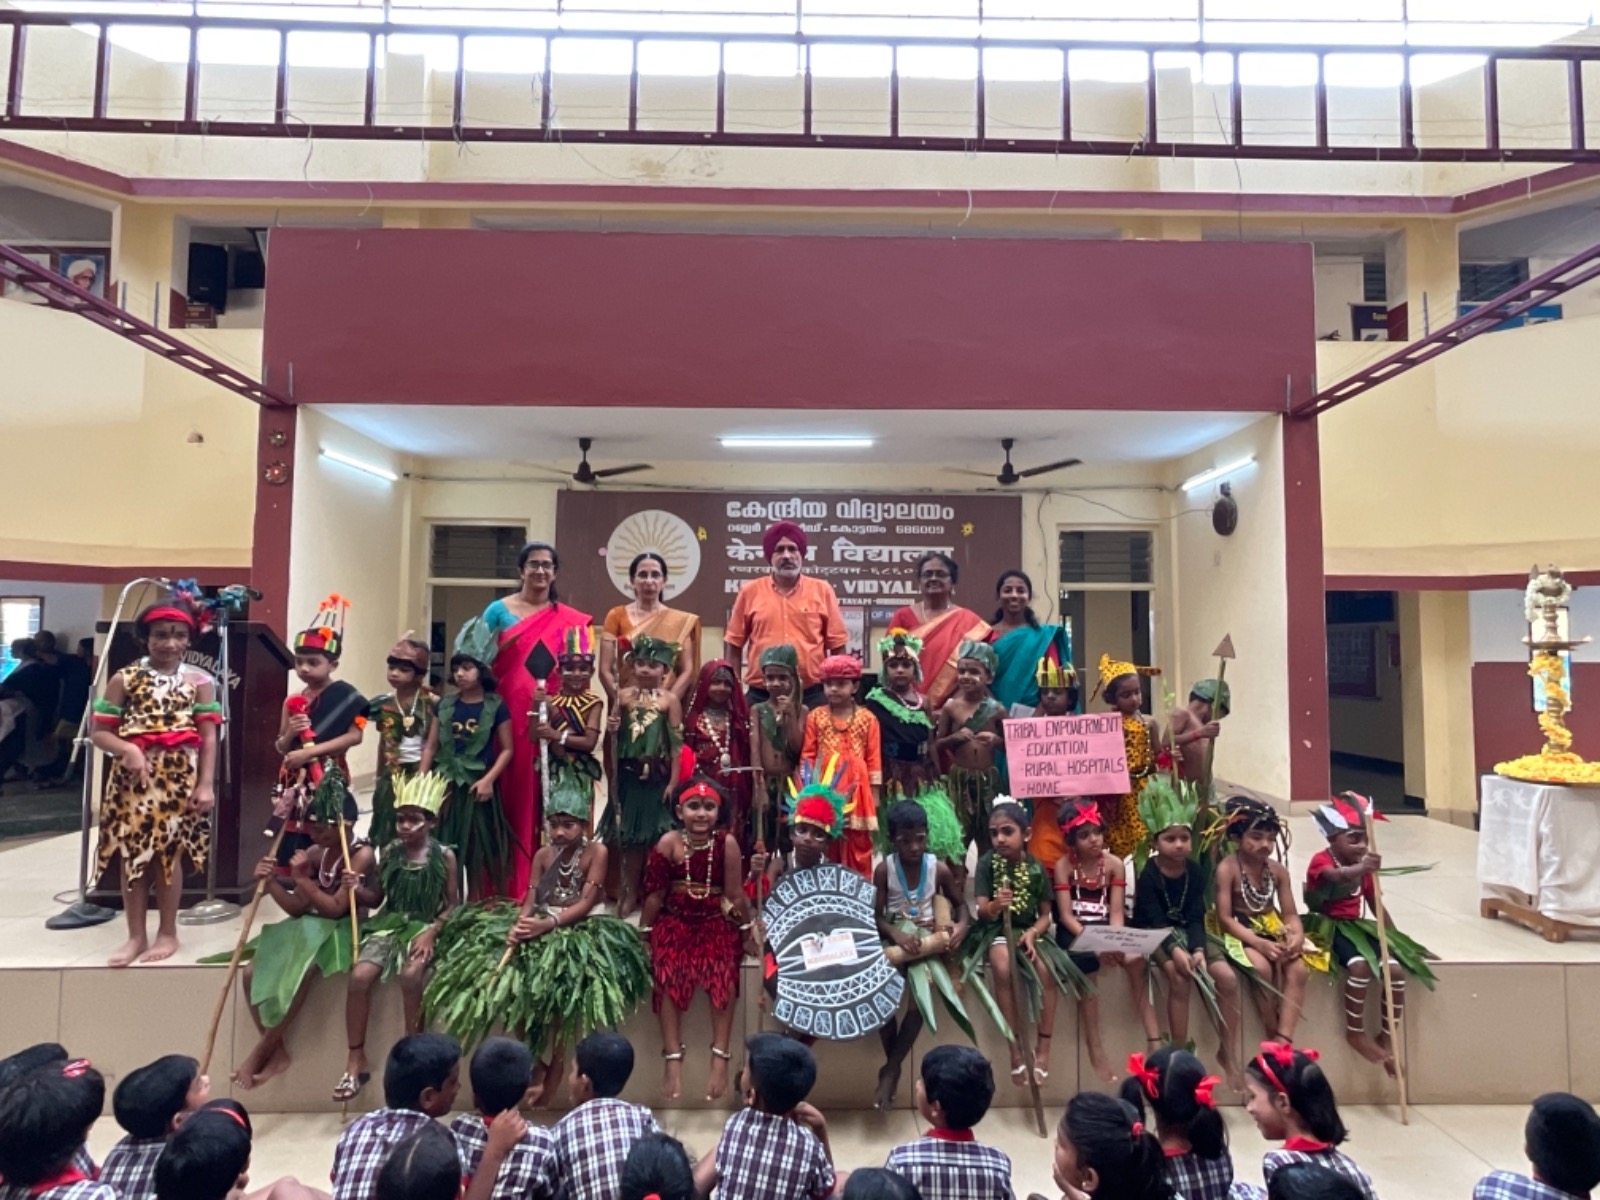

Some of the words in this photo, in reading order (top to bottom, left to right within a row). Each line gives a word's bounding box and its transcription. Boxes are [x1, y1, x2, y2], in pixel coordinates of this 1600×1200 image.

[726, 497, 828, 521] കേന്ദ്രീയ
[836, 497, 955, 523] വിദ്യാലയം
[895, 525, 945, 534] 686009
[842, 580, 922, 594] VIDYAL
[1006, 722, 1042, 740] TRIBAL
[1045, 716, 1121, 737] EMPOWERMENT
[1067, 757, 1125, 775] HOSPITALS
